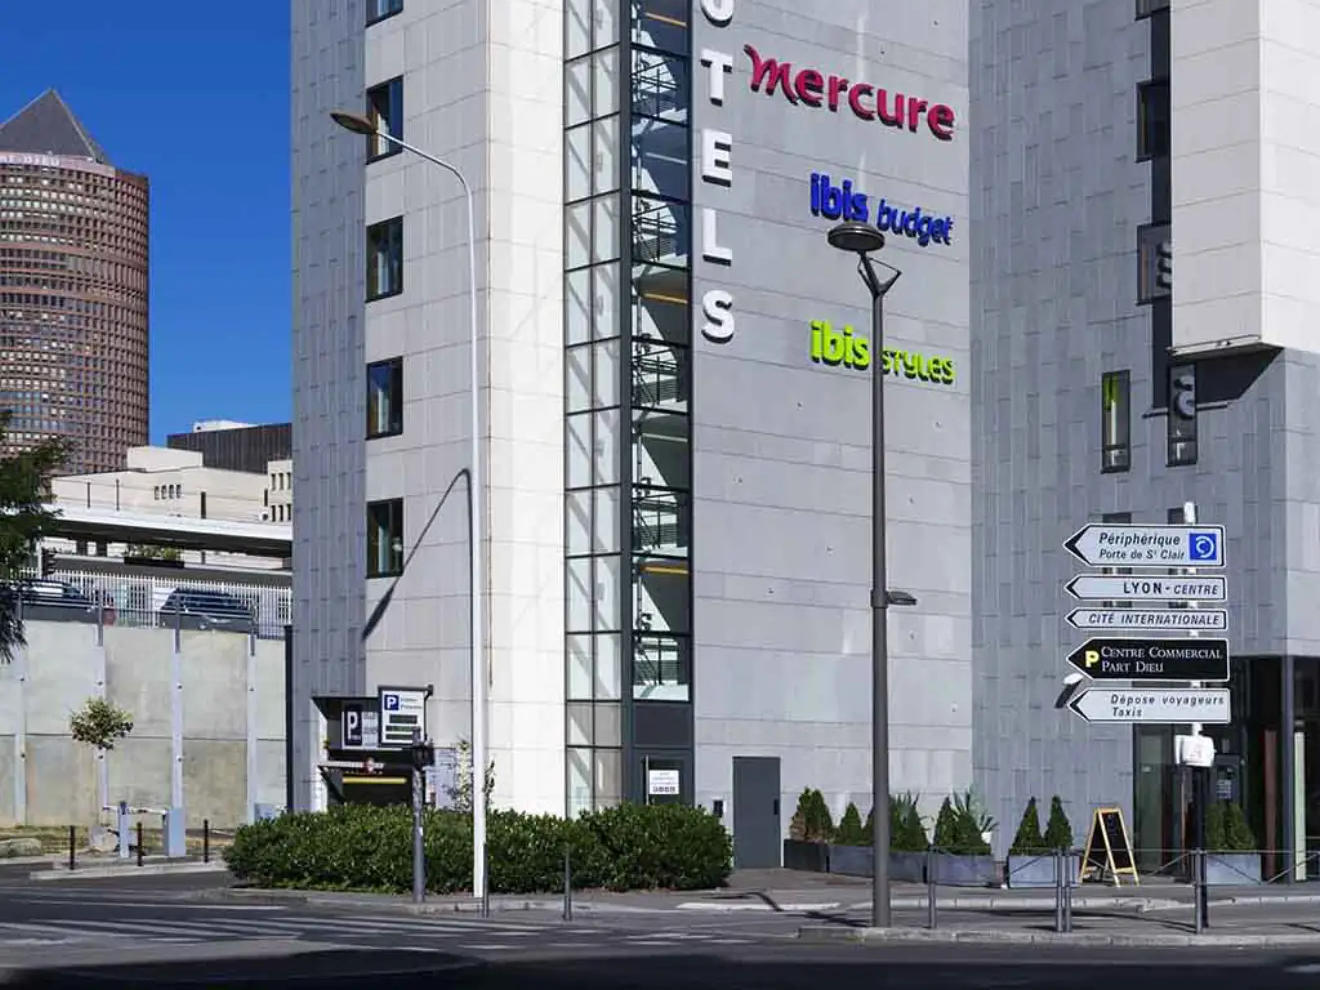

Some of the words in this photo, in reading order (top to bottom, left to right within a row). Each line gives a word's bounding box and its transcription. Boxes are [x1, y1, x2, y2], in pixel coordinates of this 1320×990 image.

[810, 172, 868, 223] ibis
[877, 198, 954, 247] budget
[809, 319, 870, 370] ibis
[1099, 532, 1181, 547] Périphérique
[1099, 549, 1126, 559] Porte
[1130, 549, 1143, 559] de
[1160, 549, 1185, 560] Clair
[1089, 613, 1115, 624] CITÉ
[1121, 614, 1219, 625] INTERNATIONALE
[1085, 649, 1100, 668] P
[1110, 694, 1155, 706] Dépose
[1162, 696, 1224, 707] voyageurs
[1112, 707, 1143, 717] Taxis
